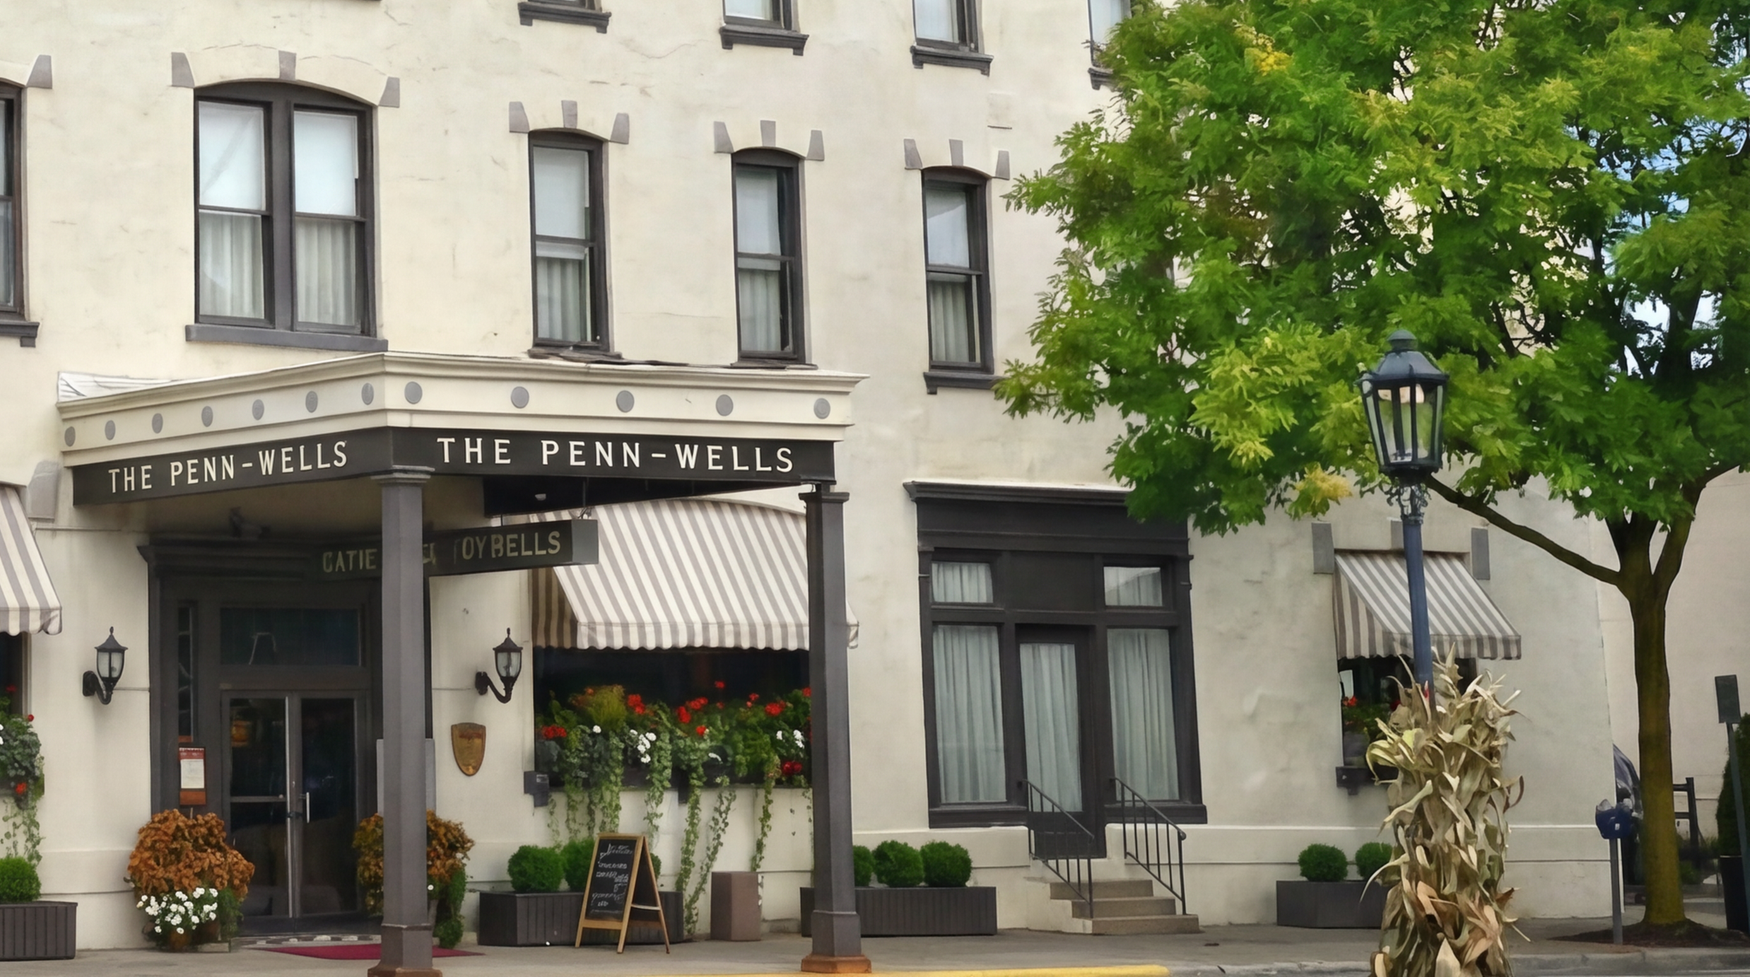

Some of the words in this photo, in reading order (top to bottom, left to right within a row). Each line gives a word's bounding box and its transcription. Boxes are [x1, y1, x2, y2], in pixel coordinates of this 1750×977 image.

[108, 465, 152, 493] THE
[170, 440, 347, 486] PENN-WELLS
[437, 437, 511, 465] THE
[541, 440, 794, 473] PENN-WELLS
